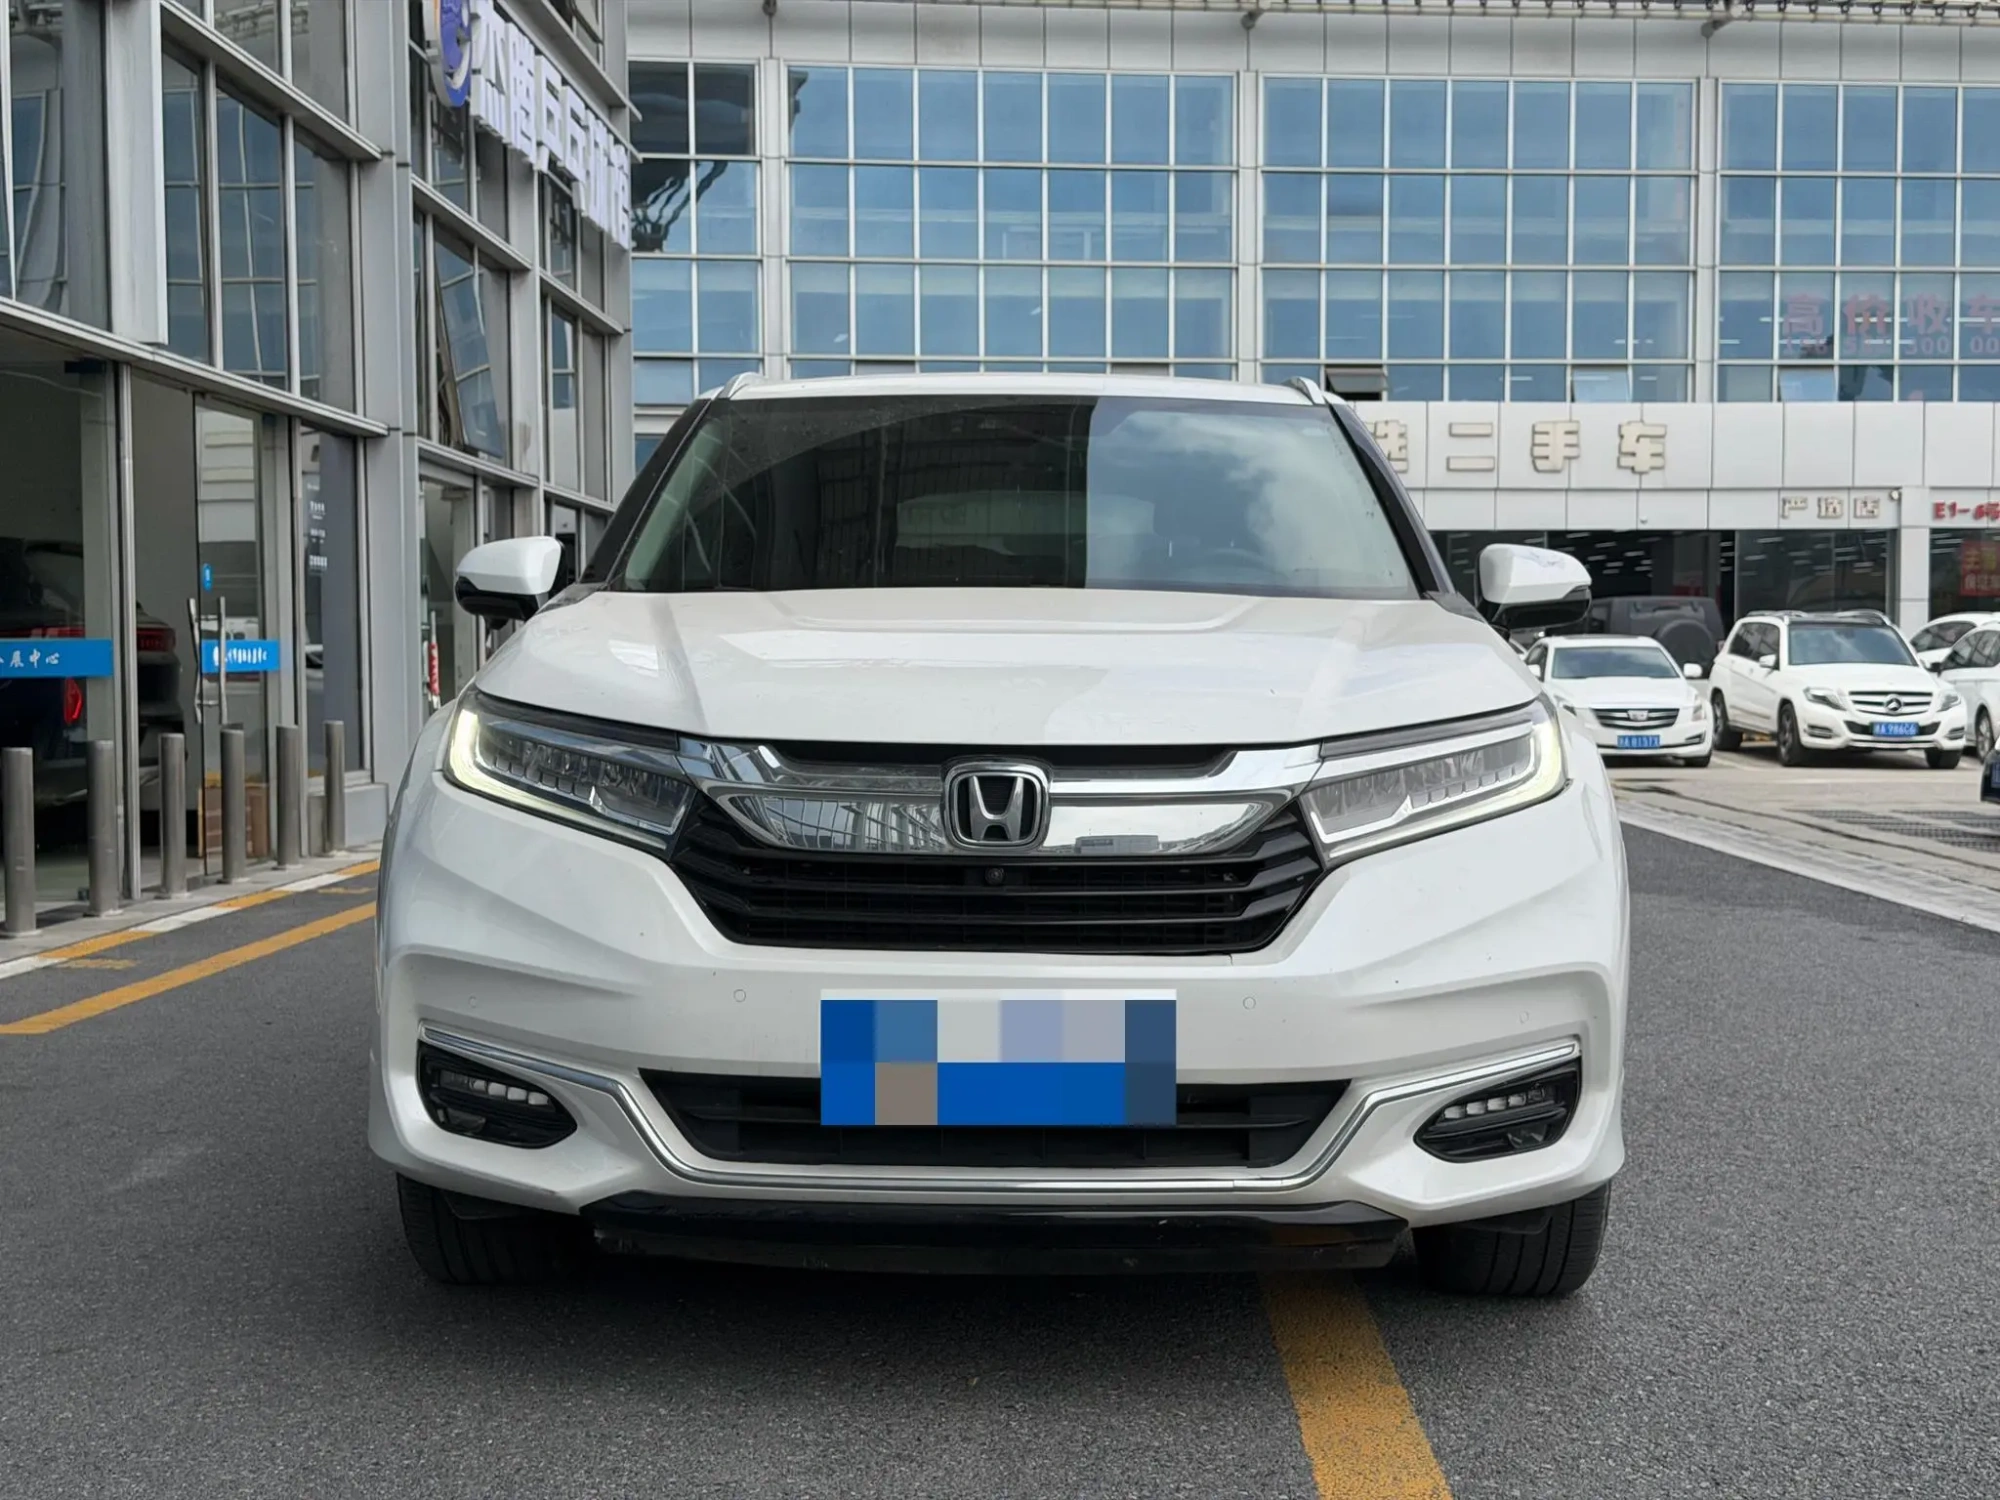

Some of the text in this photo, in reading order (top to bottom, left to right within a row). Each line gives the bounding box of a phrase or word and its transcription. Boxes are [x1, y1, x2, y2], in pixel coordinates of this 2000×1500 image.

[1782, 293, 2000, 335] 高价收车
[0, 647, 60, 669] 展中心
